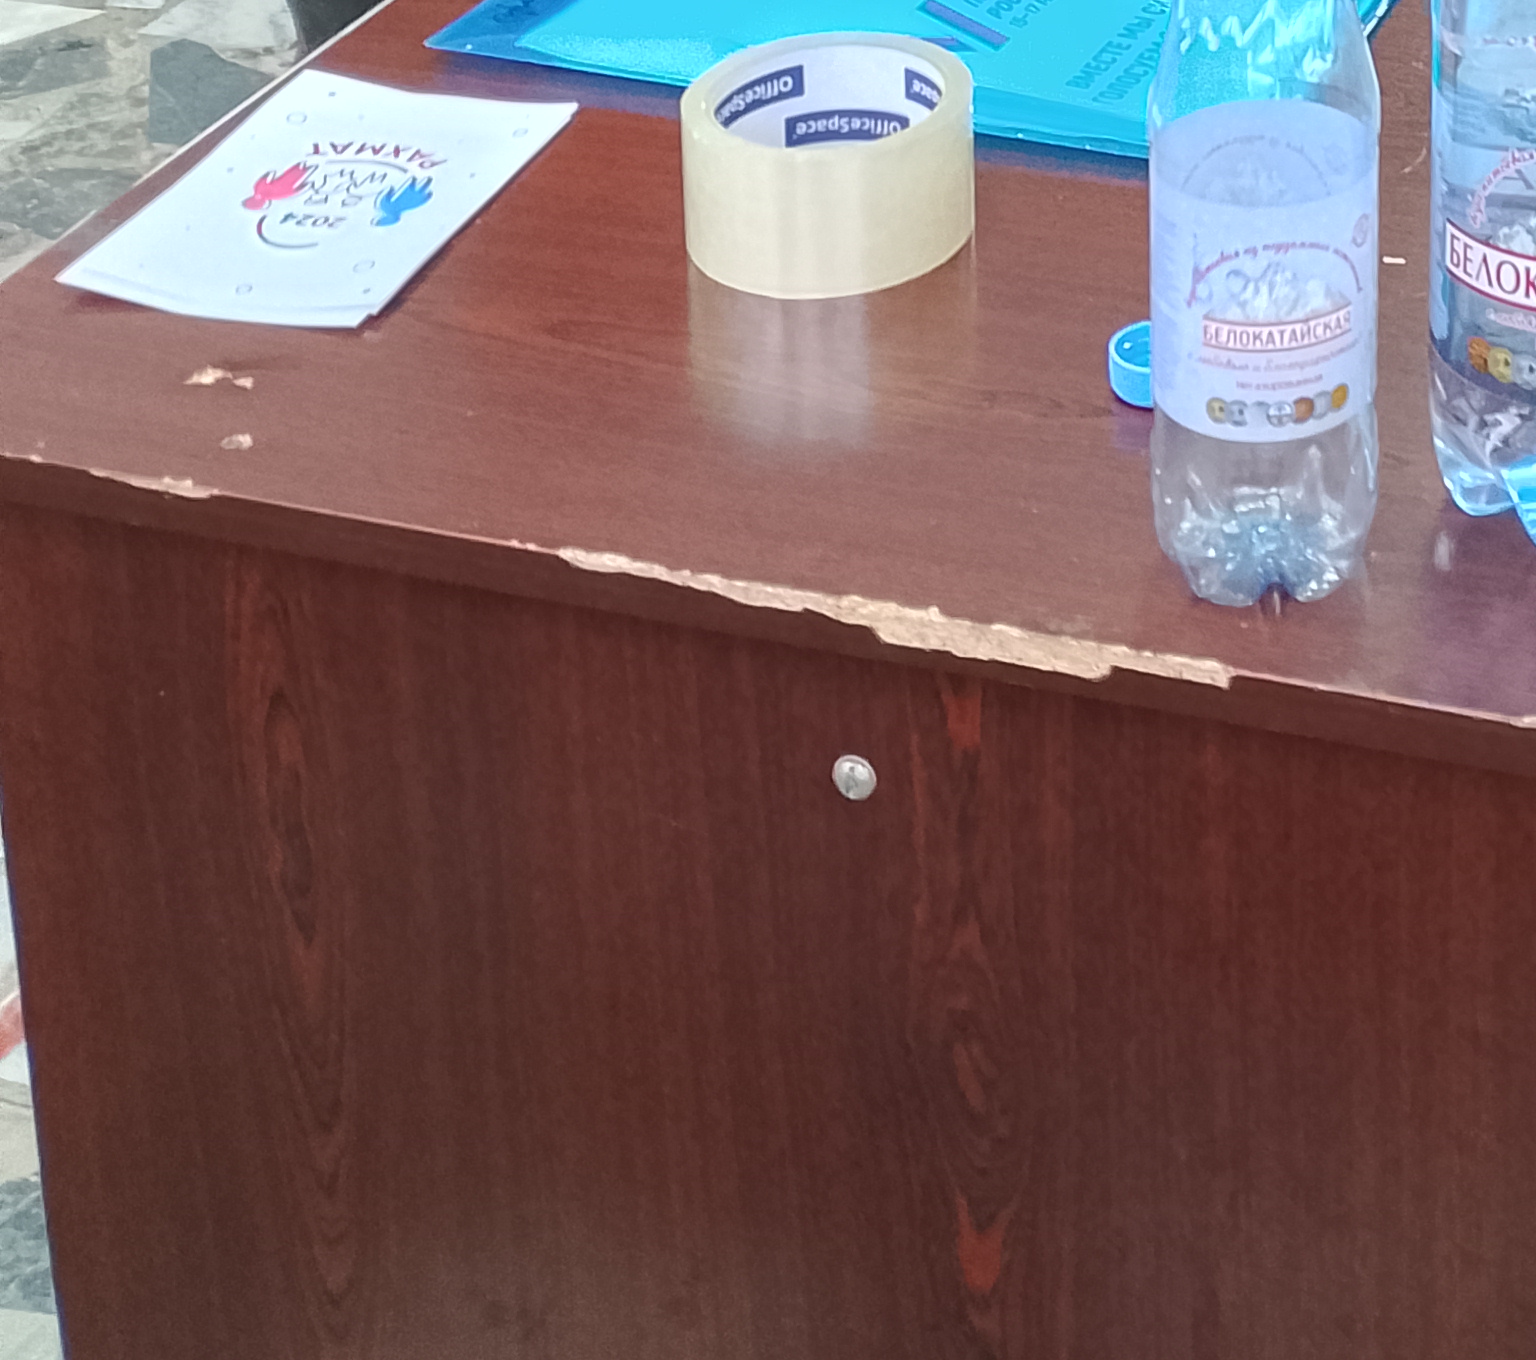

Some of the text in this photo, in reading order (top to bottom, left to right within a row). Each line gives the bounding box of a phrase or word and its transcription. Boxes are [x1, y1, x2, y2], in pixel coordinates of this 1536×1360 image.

[1064, 40, 1132, 90] ВМЕСТЕ
[1116, 15, 1156, 40] МЫ
[795, 115, 901, 136] OfficeSpace
[1203, 310, 1351, 348] БЕЛОКАТАЙСКАЯ
